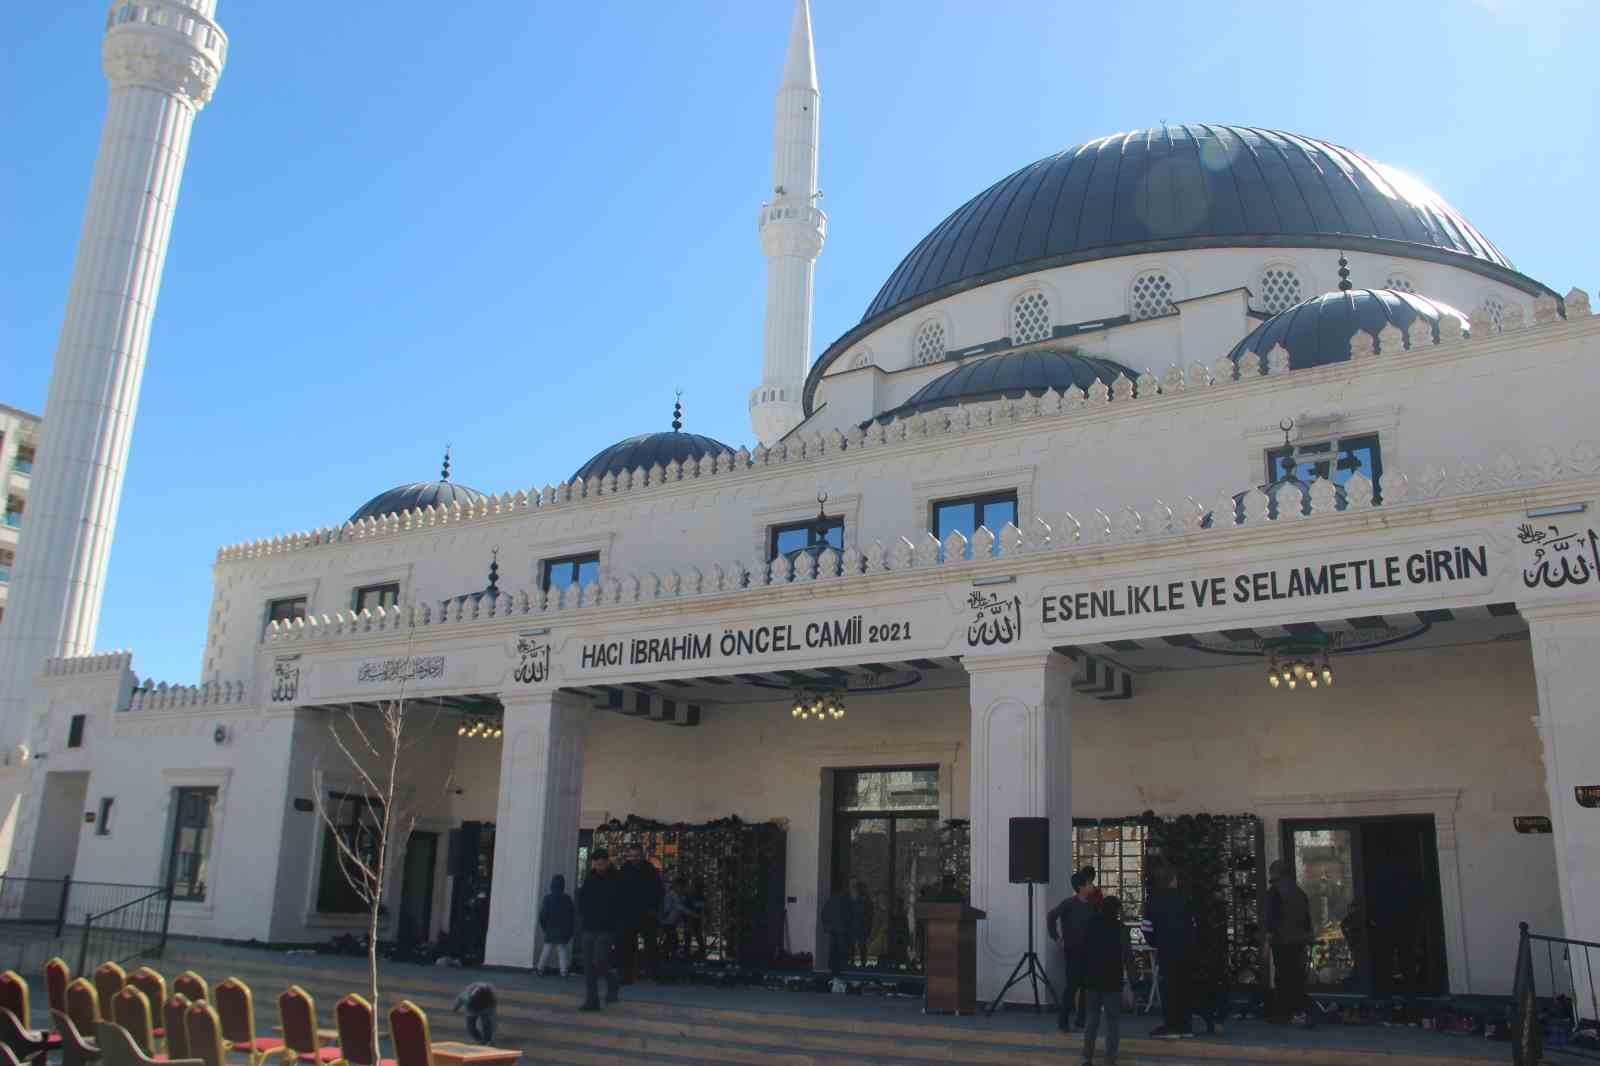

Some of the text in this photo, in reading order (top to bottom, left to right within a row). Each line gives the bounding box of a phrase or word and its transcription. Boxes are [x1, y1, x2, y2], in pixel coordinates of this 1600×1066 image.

[1042, 545, 1488, 623] ESENLİKLE VE SELAMETLE GİRİN
[582, 615, 912, 668] HACI İBRAHİM ÖNCEL CAMİİ 2021
